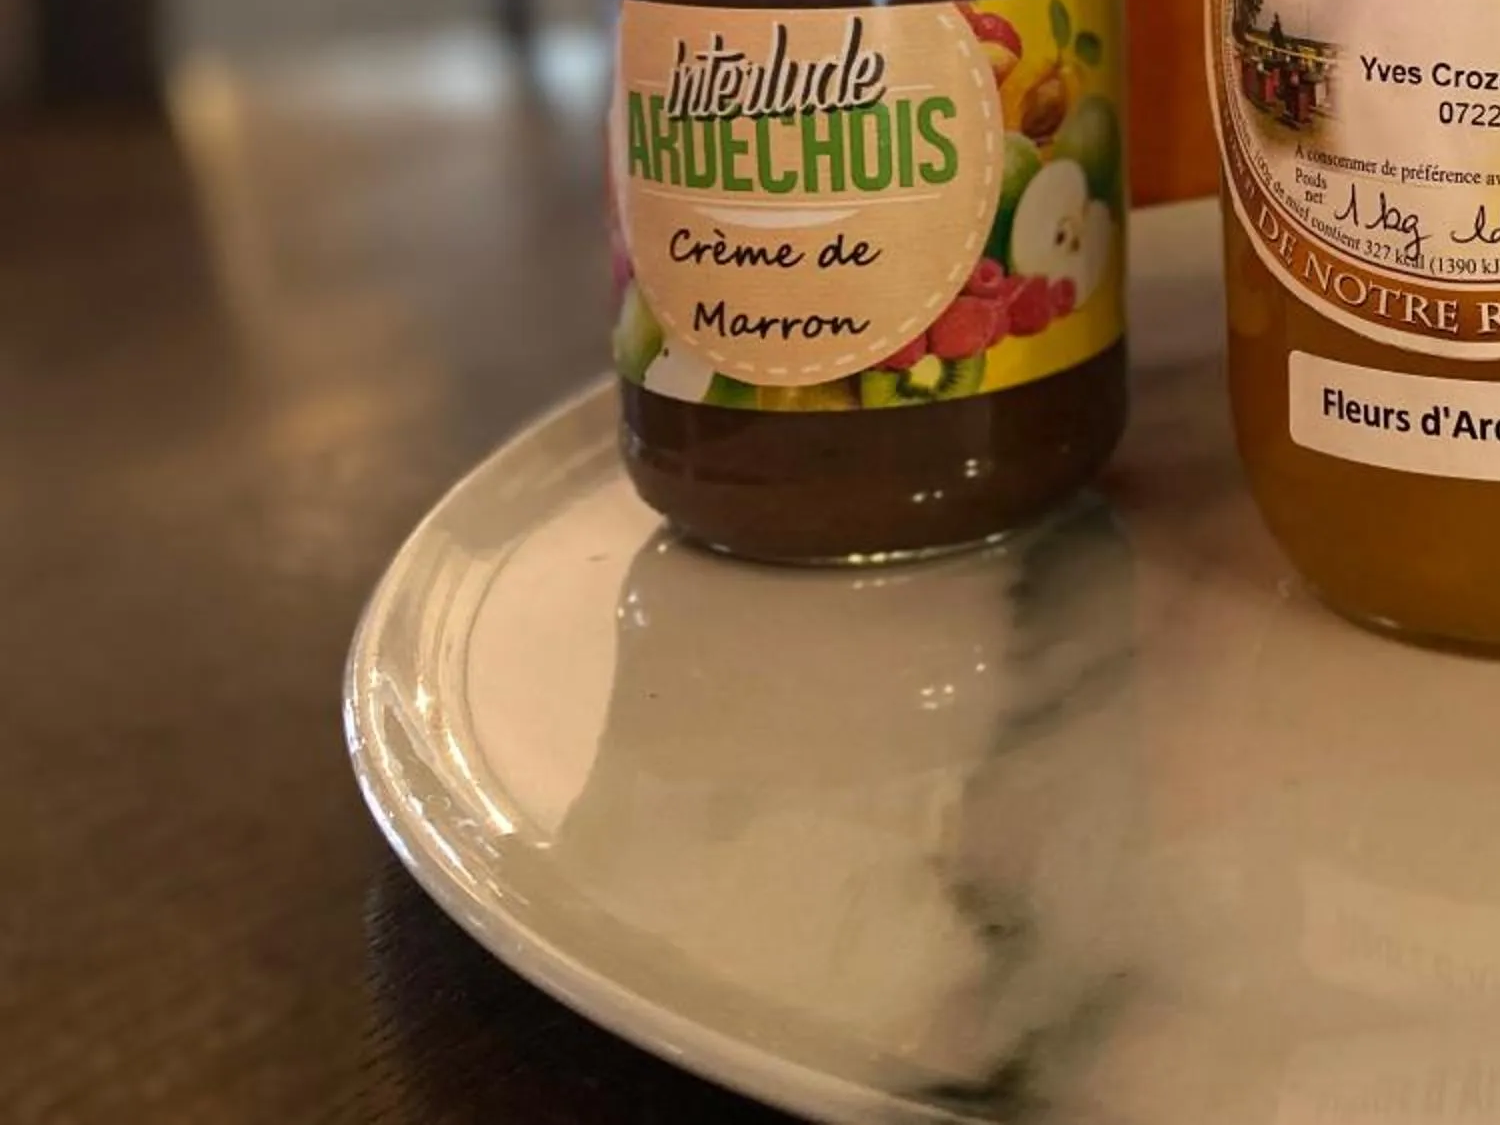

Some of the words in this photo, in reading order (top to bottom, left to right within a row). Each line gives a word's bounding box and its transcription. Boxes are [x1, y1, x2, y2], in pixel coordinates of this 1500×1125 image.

[1359, 55, 1423, 86] Yves
[1295, 166, 1327, 190] Poids
[1381, 158, 1397, 177] de
[1401, 162, 1481, 185] préférence
[1304, 190, 1323, 204] net
[1335, 182, 1359, 227] 1
[1366, 191, 1432, 261] kg
[669, 228, 806, 268] Crème
[817, 234, 883, 268] de
[1311, 216, 1361, 251] contient
[1363, 239, 1391, 261] 327
[1429, 255, 1477, 275] (1390
[1258, 206, 1297, 266] DE
[1303, 250, 1459, 334] NOTRE
[692, 300, 871, 340] Marron
[1322, 387, 1411, 432] Fleurs
